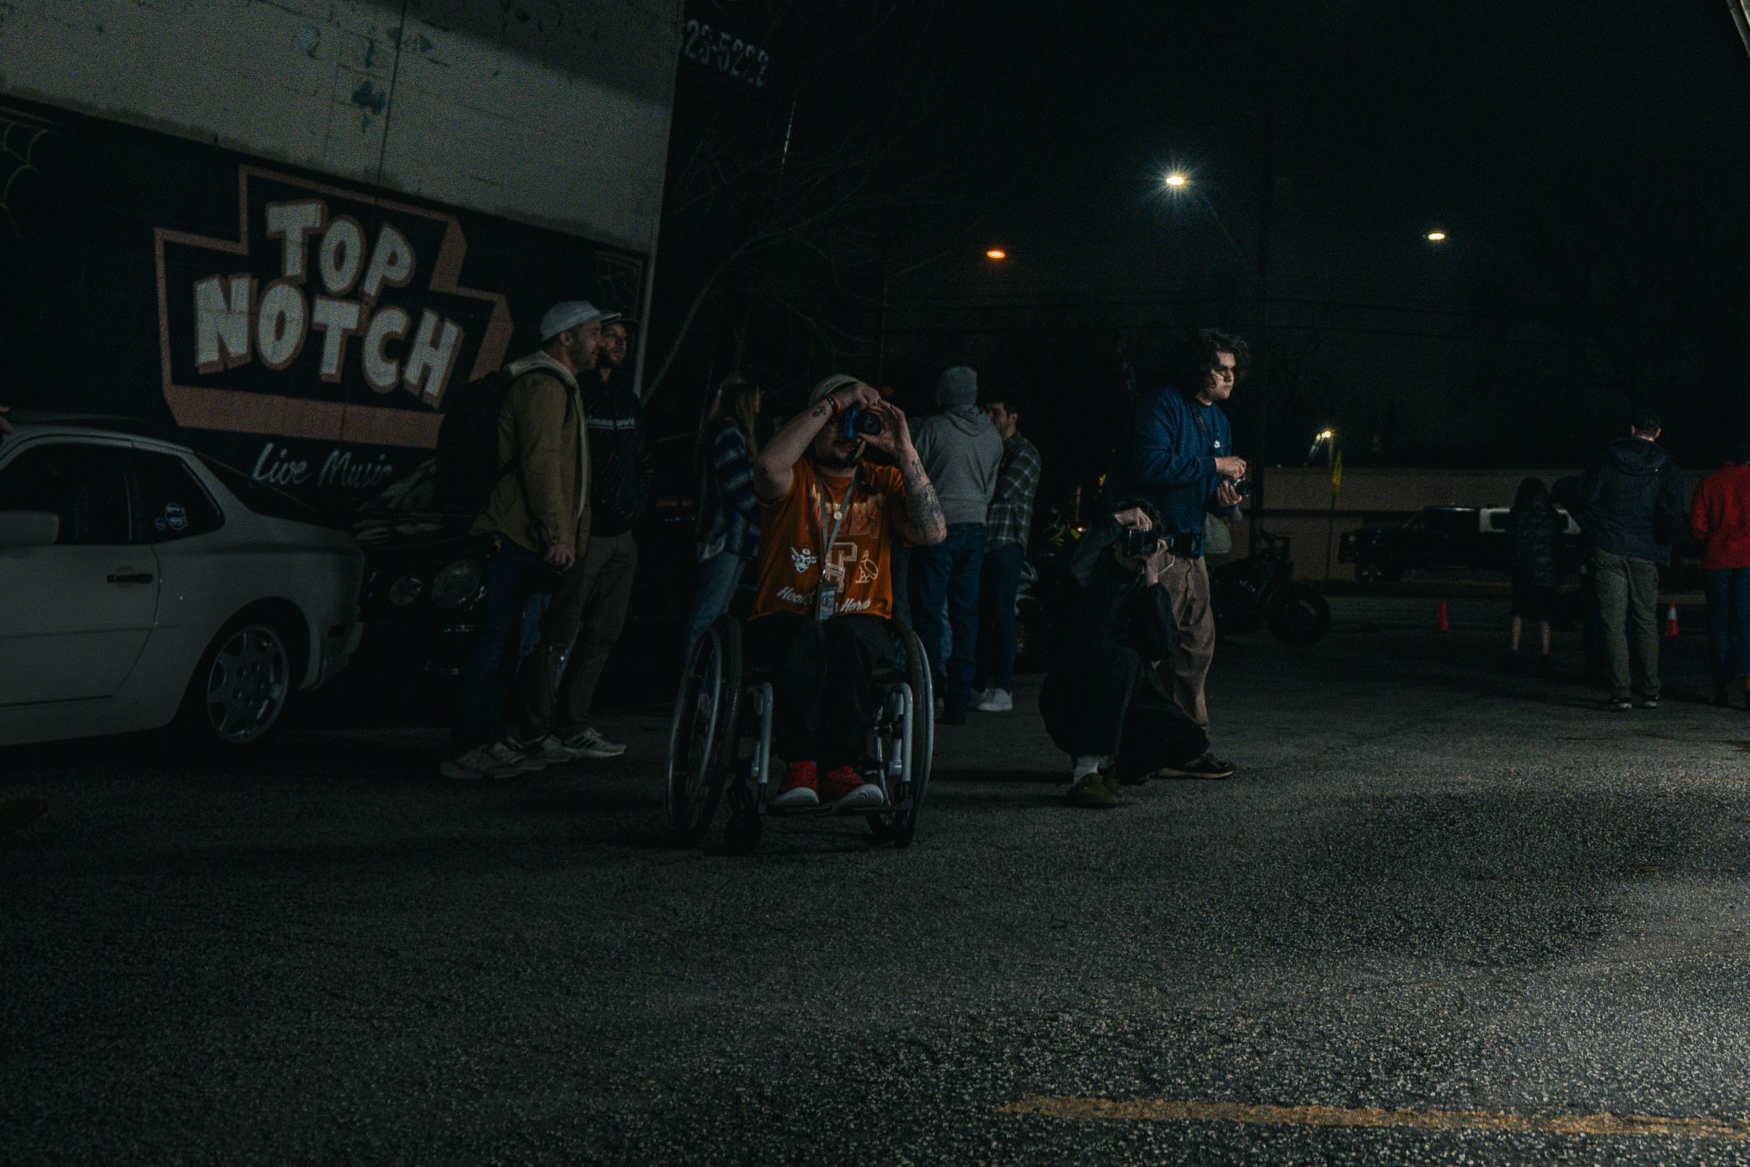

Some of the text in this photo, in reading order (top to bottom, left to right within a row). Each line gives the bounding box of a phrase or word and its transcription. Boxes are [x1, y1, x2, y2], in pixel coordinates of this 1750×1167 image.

[265, 198, 416, 308] TOP
[193, 272, 465, 410] NOTCH
[252, 442, 394, 488] Live Music
